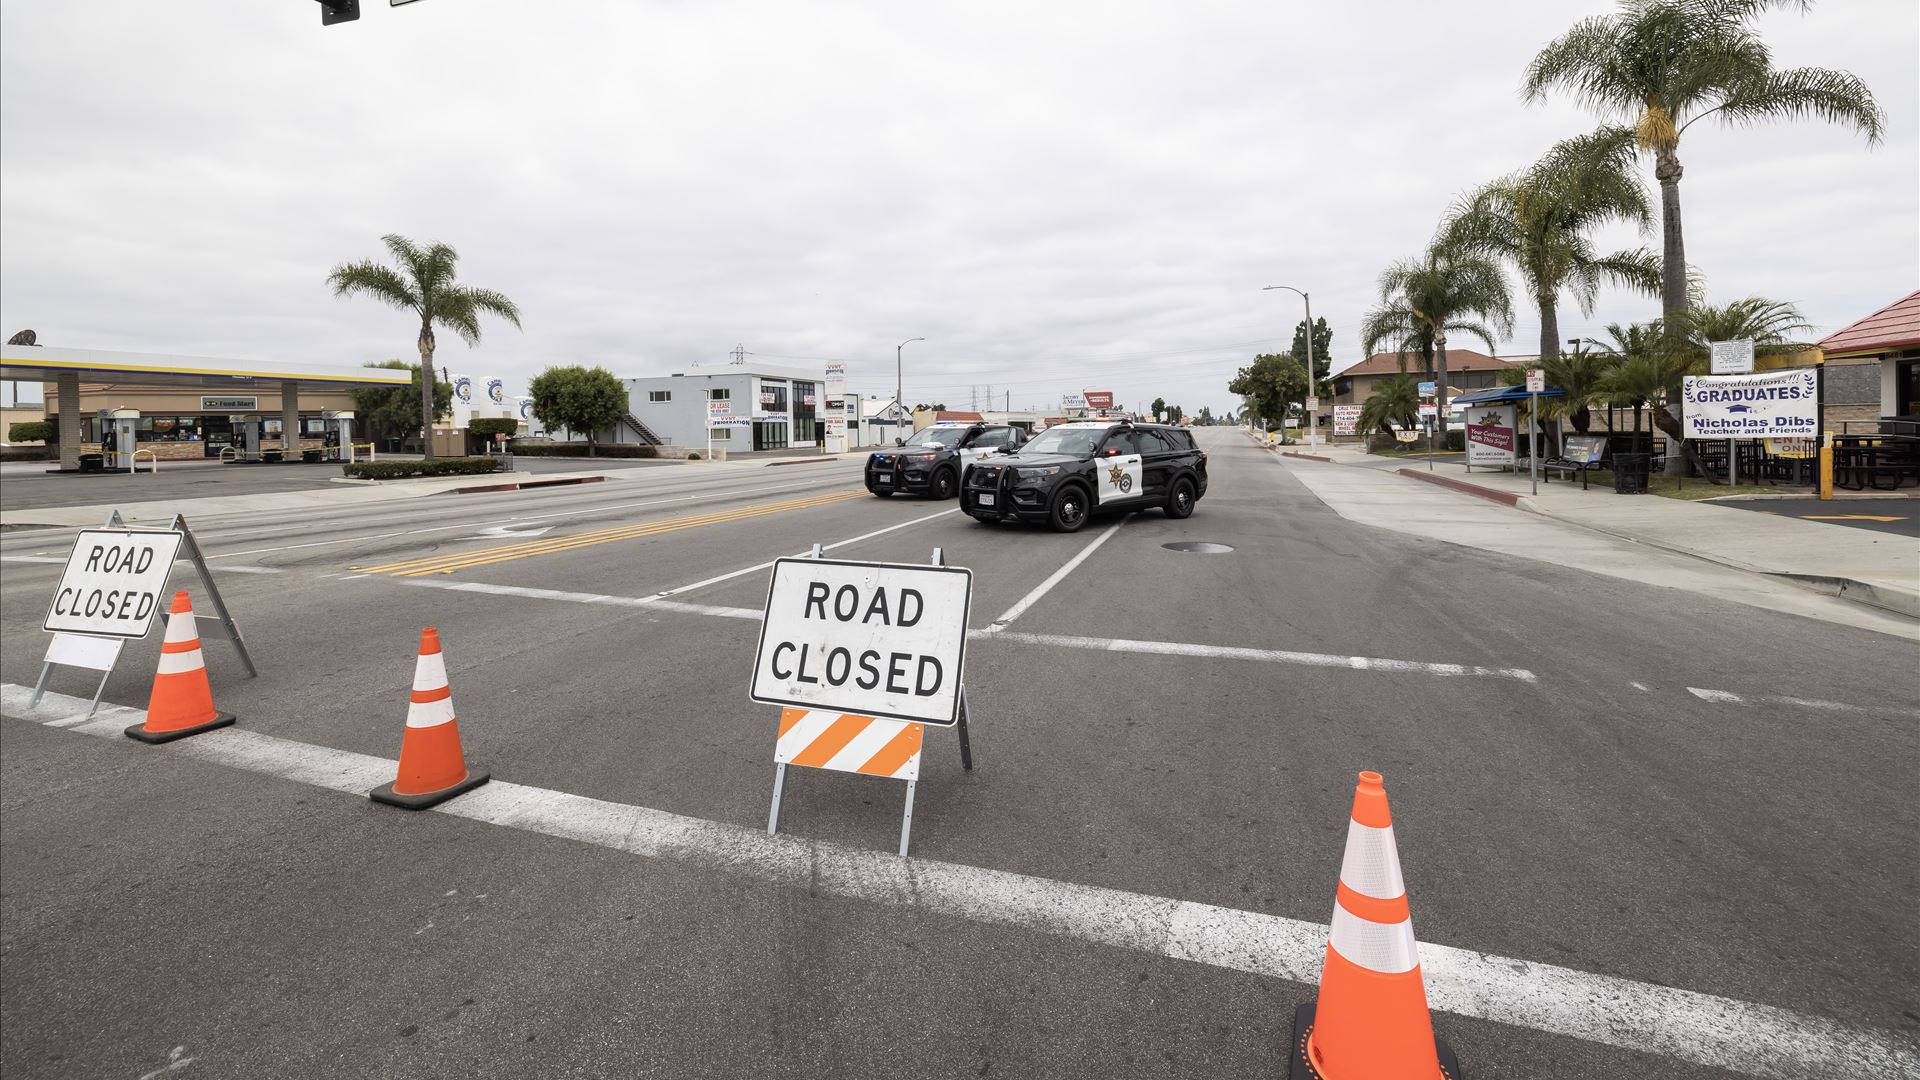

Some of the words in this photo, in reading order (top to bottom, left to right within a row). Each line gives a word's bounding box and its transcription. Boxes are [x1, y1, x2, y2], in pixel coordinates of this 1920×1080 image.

[1696, 374, 1800, 390] Congratulations!!!
[1697, 387, 1800, 403] GRADUATES
[1693, 418, 1768, 428] Nicholas
[1775, 416, 1815, 427] Dibs
[1769, 426, 1812, 434] Friends
[1483, 431, 1510, 440] Customers
[85, 545, 154, 574] ROAD
[55, 587, 154, 620] CLOSED
[804, 582, 924, 627] ROAD
[772, 641, 943, 696] CLOSED
